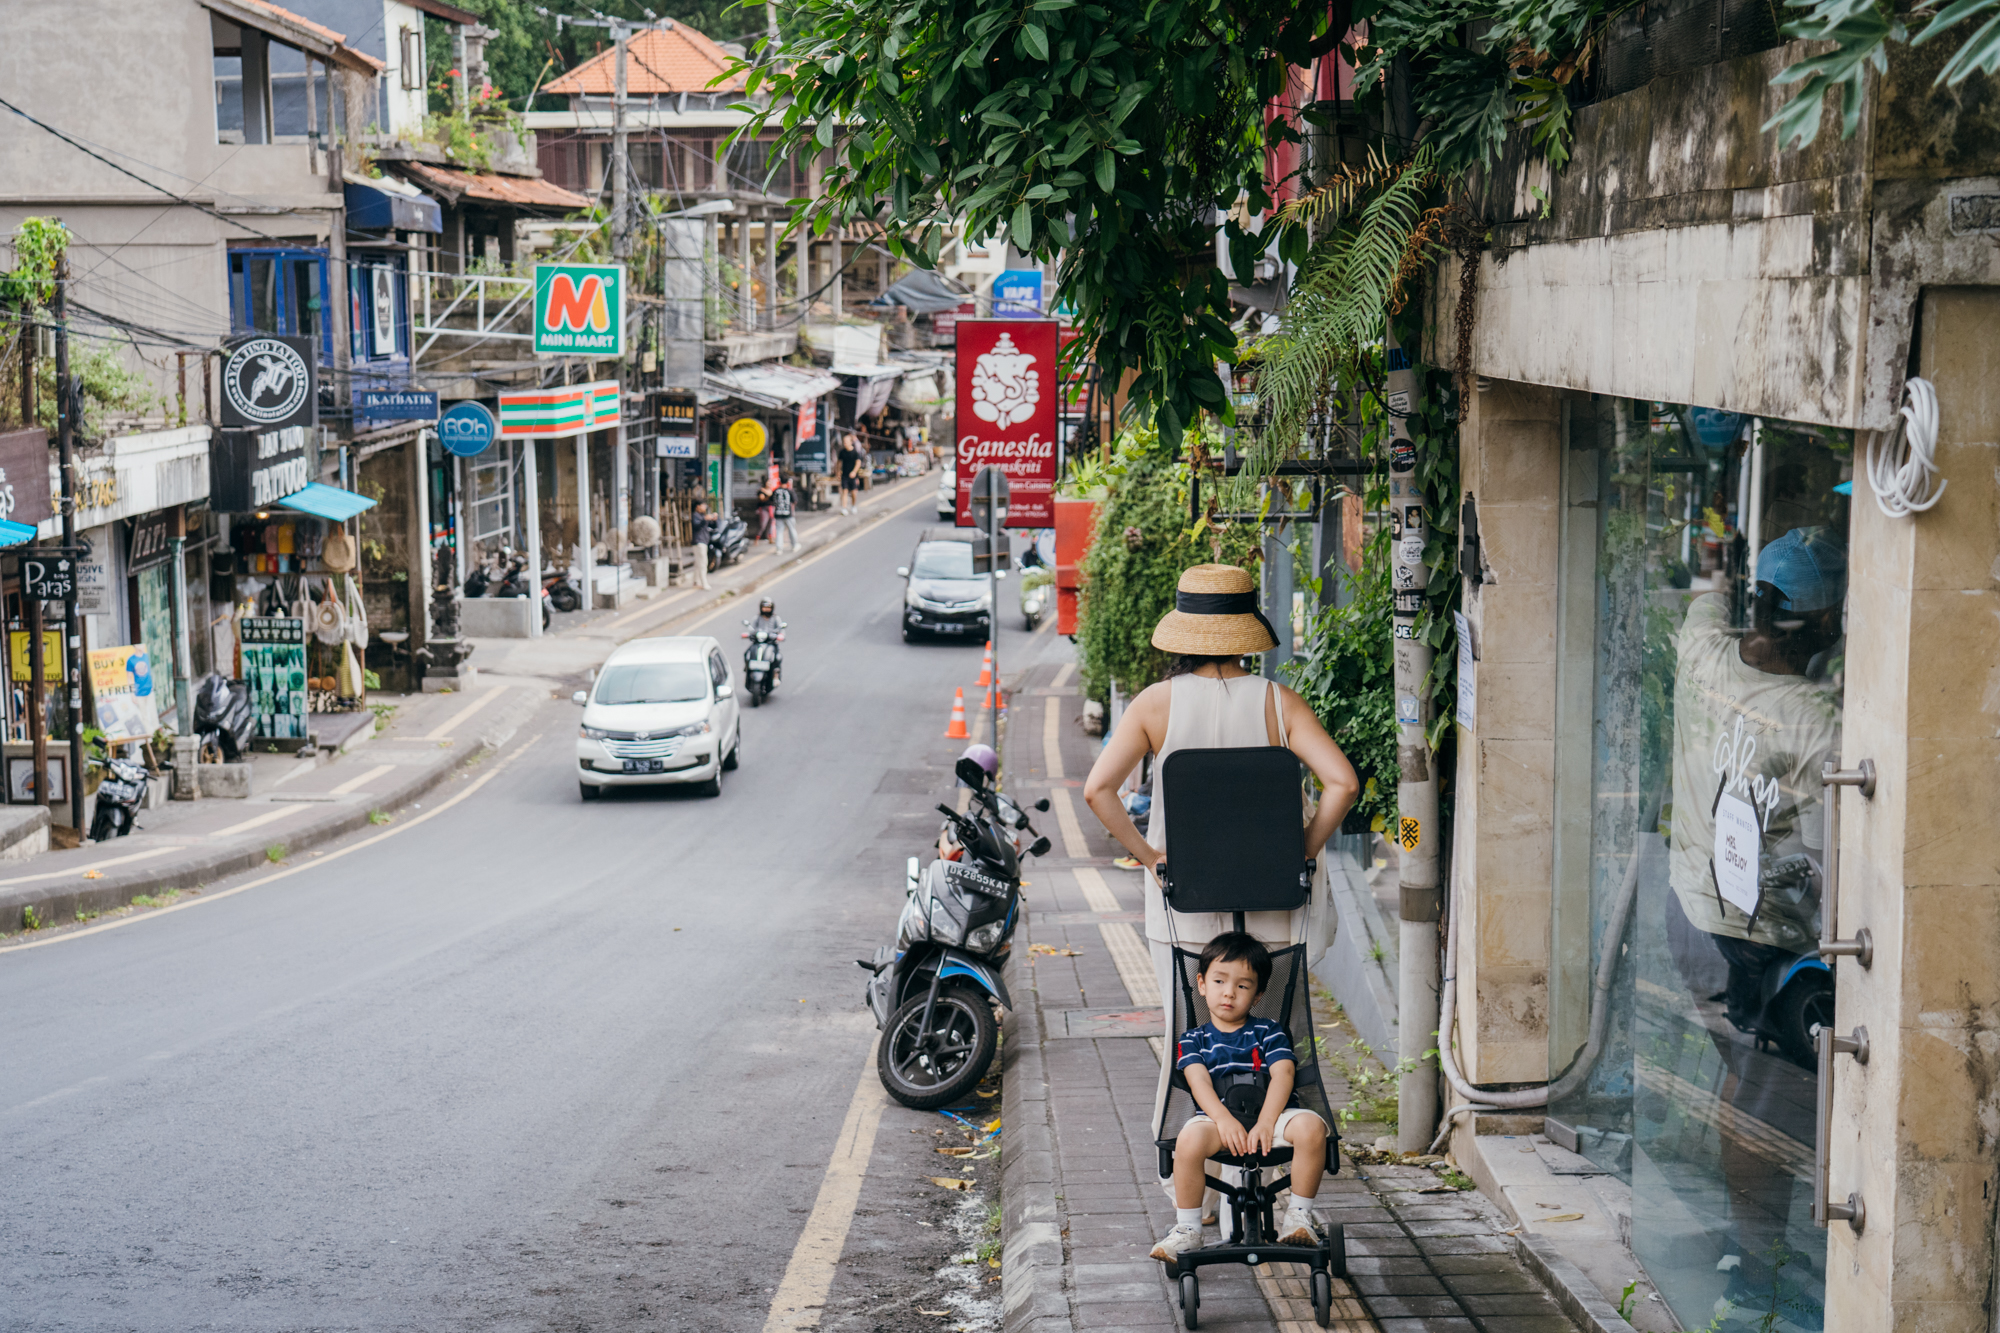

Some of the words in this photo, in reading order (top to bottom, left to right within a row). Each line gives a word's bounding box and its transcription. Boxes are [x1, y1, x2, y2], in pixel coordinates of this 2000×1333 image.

[1002, 286, 1035, 299] VAPE
[540, 333, 573, 346] MINI
[574, 334, 615, 347] MART
[228, 356, 243, 377] YAN
[241, 342, 270, 357] TINO
[271, 343, 305, 379] TATTOO
[367, 393, 433, 405] IKATBATIK
[665, 444, 691, 454] VISA
[958, 432, 1053, 465] Ganesha
[25, 561, 72, 598] Paras
[252, 619, 269, 628] YAN
[243, 629, 302, 640] TATTOO
[94, 658, 115, 669] BUY
[97, 678, 114, 686] Get
[108, 684, 136, 696] FREE
[1713, 714, 1779, 832] Shop
[1722, 808, 1735, 822] STAFF
[1736, 815, 1753, 833] WANTED
[1725, 848, 1748, 872] LOVEJOY
